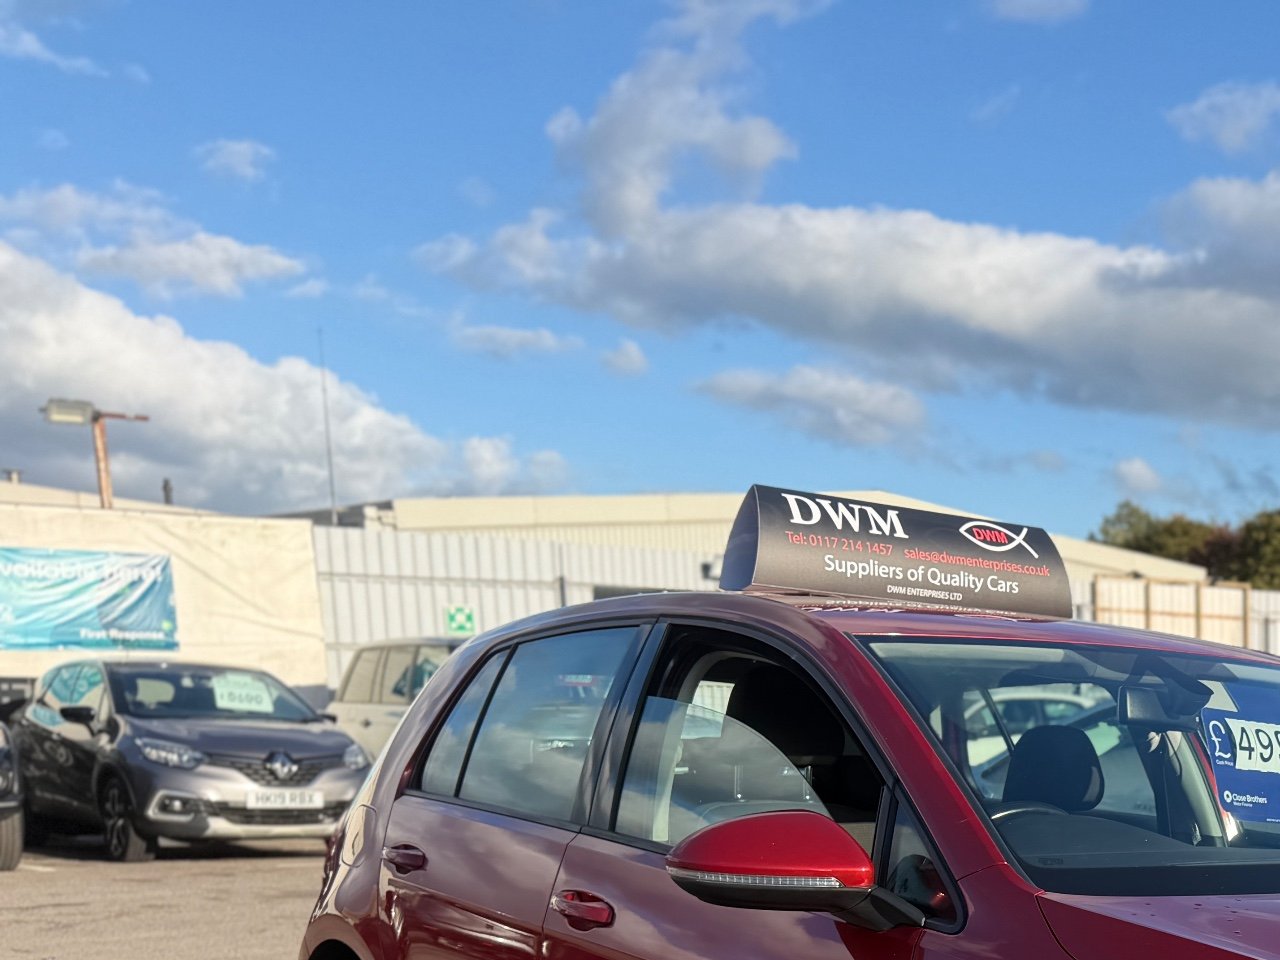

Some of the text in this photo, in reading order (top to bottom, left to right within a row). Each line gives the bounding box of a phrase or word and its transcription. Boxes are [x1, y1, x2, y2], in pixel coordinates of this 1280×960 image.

[781, 492, 910, 539] DWM
[972, 526, 1009, 545] DWM
[785, 530, 1051, 577] Tel: 0117 214 1457 sales@dwmenterprises.co.uk
[824, 554, 1019, 594] Suppliers of Quality Cars
[887, 584, 963, 601] DWM ENTERPRISES LTD
[1232, 793, 1268, 804] Close Brothers
